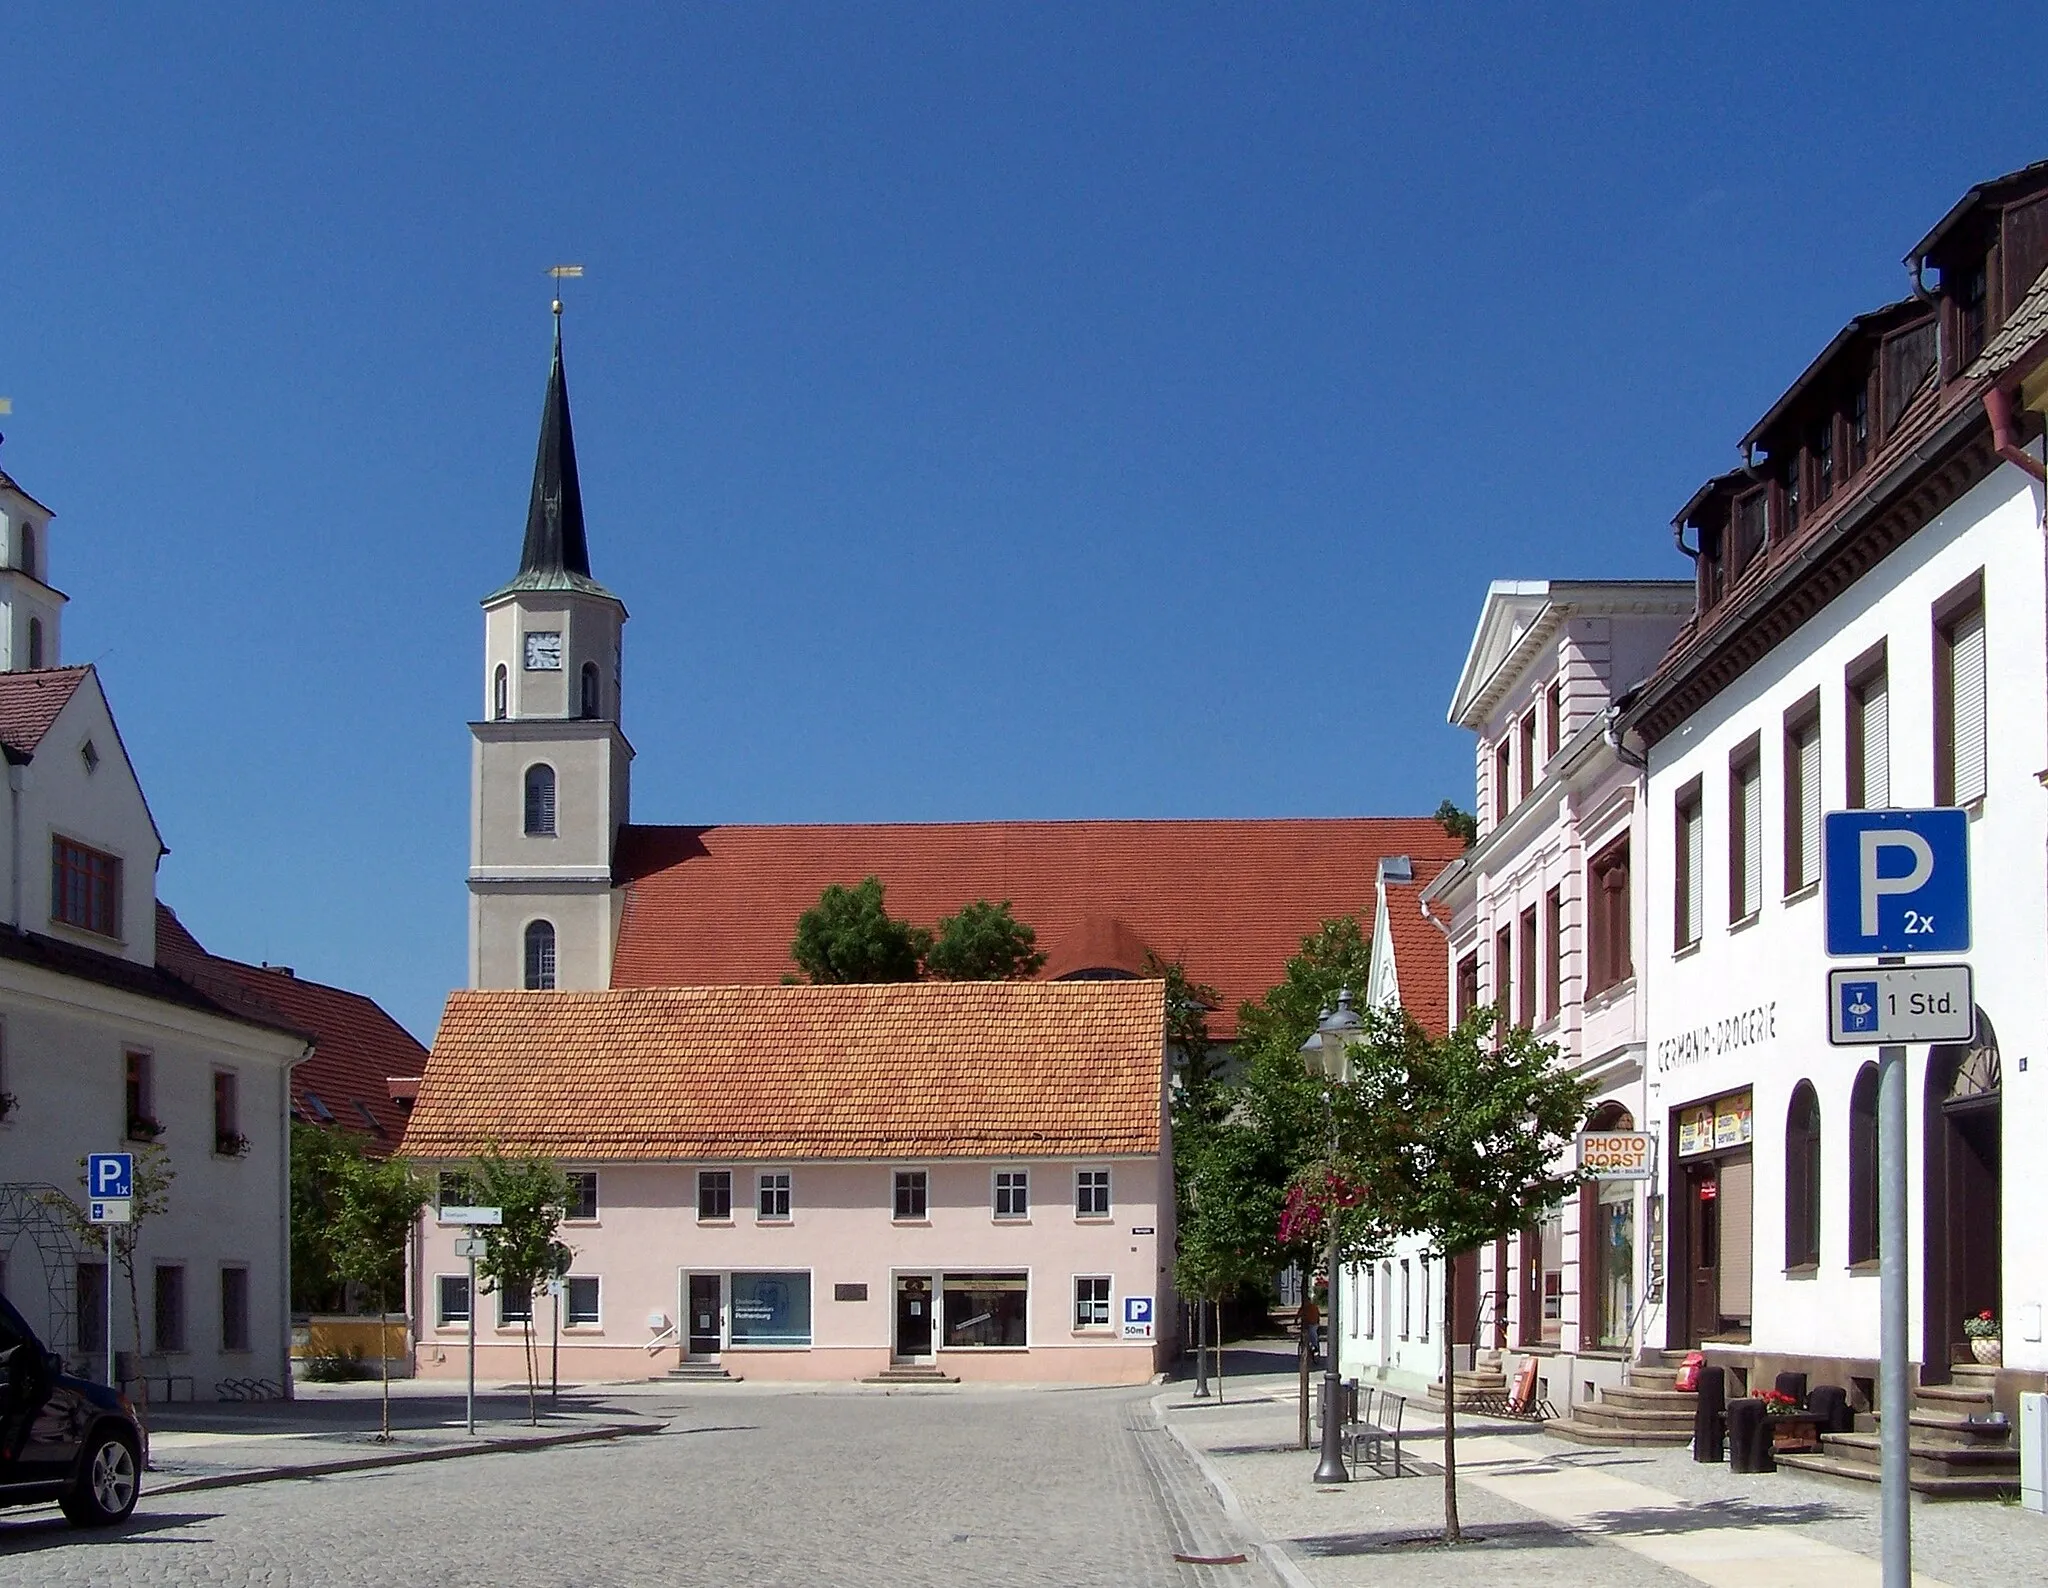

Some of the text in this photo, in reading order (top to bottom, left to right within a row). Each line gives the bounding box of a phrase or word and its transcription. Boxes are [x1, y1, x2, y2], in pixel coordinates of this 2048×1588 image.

[1859, 829, 1935, 938] P
[1903, 910, 1935, 934] 2x
[1887, 991, 1958, 1016] 1 Std.
[1584, 1137, 1646, 1152] PHOTO
[99, 1159, 122, 1193] P
[116, 1182, 129, 1195] 1x
[1130, 1300, 1148, 1320] P
[1125, 1326, 1145, 1335] 50m
